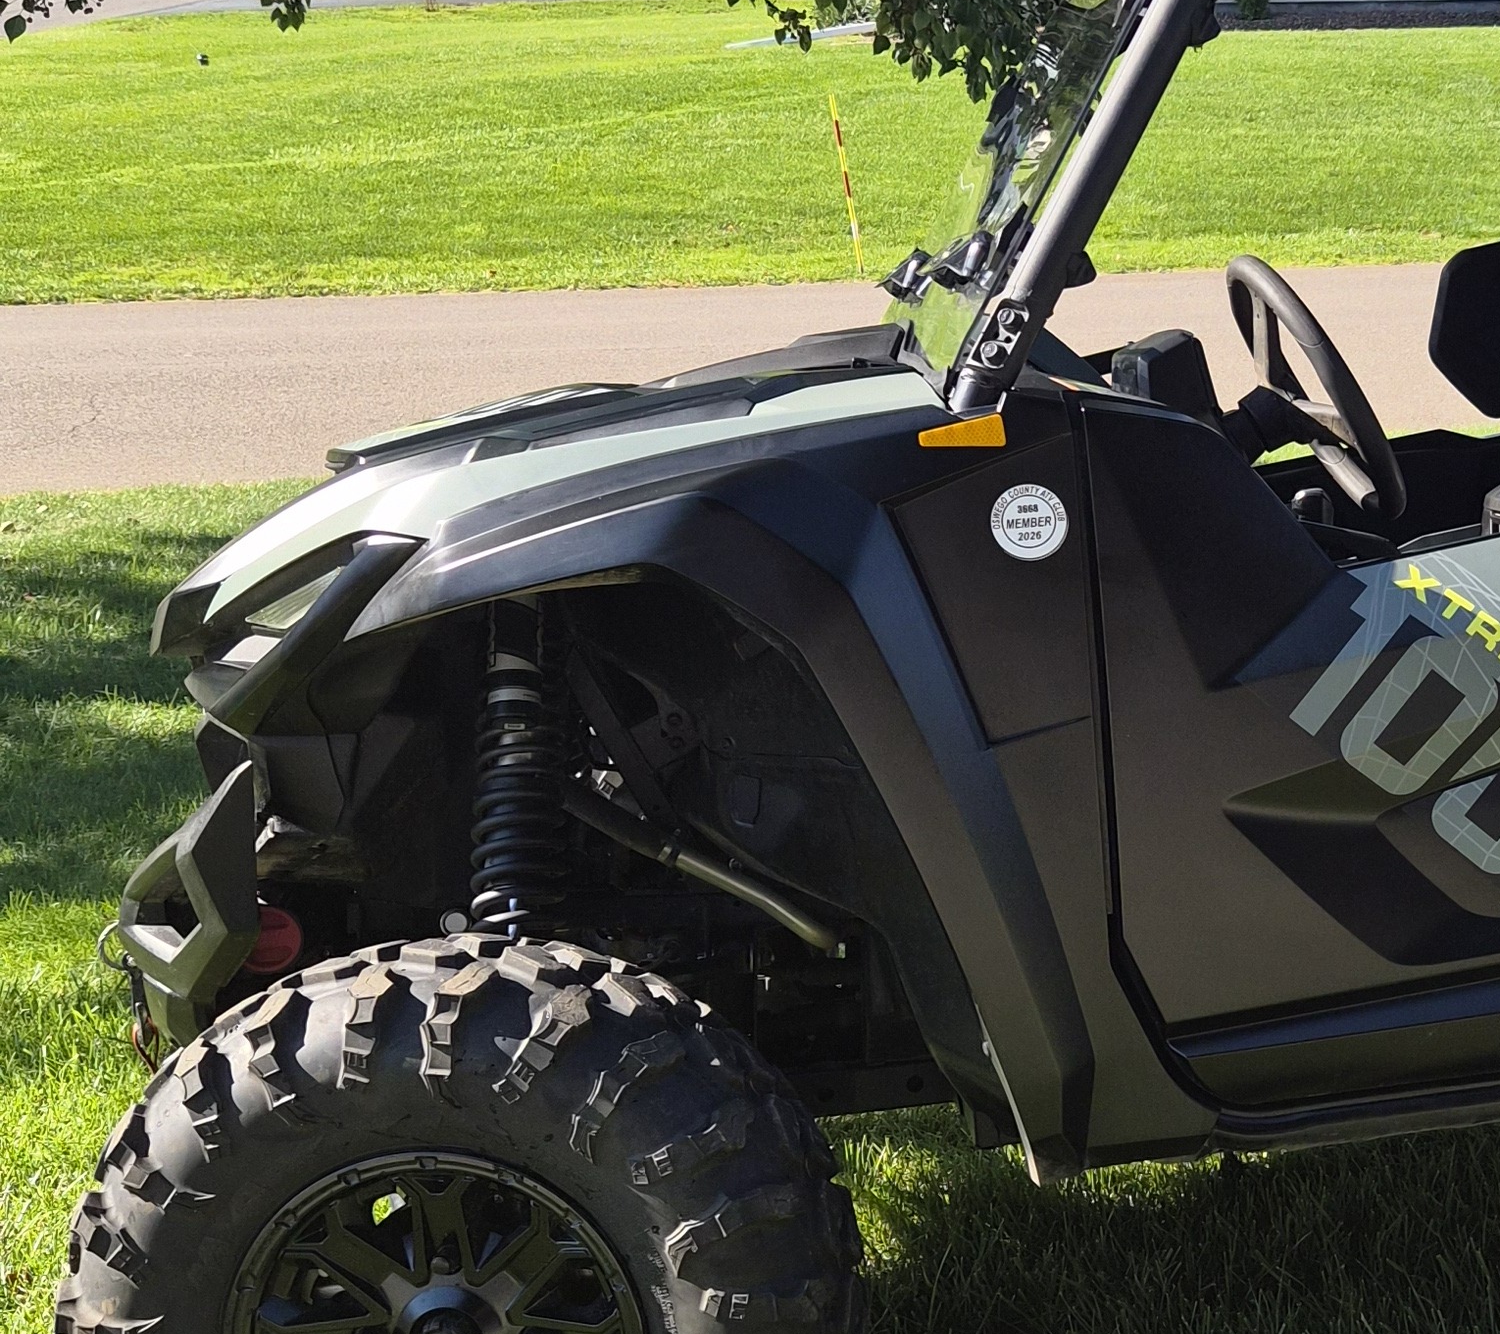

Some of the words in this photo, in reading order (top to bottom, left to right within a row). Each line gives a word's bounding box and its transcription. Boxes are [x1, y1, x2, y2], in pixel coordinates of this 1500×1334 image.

[992, 496, 1008, 529] OSWEGO
[1008, 486, 1041, 499] COUNTY
[1040, 490, 1055, 502] ATV
[1053, 502, 1065, 522] CLUB
[1006, 515, 1052, 530] MEMBER
[1018, 531, 1042, 541] 2026
